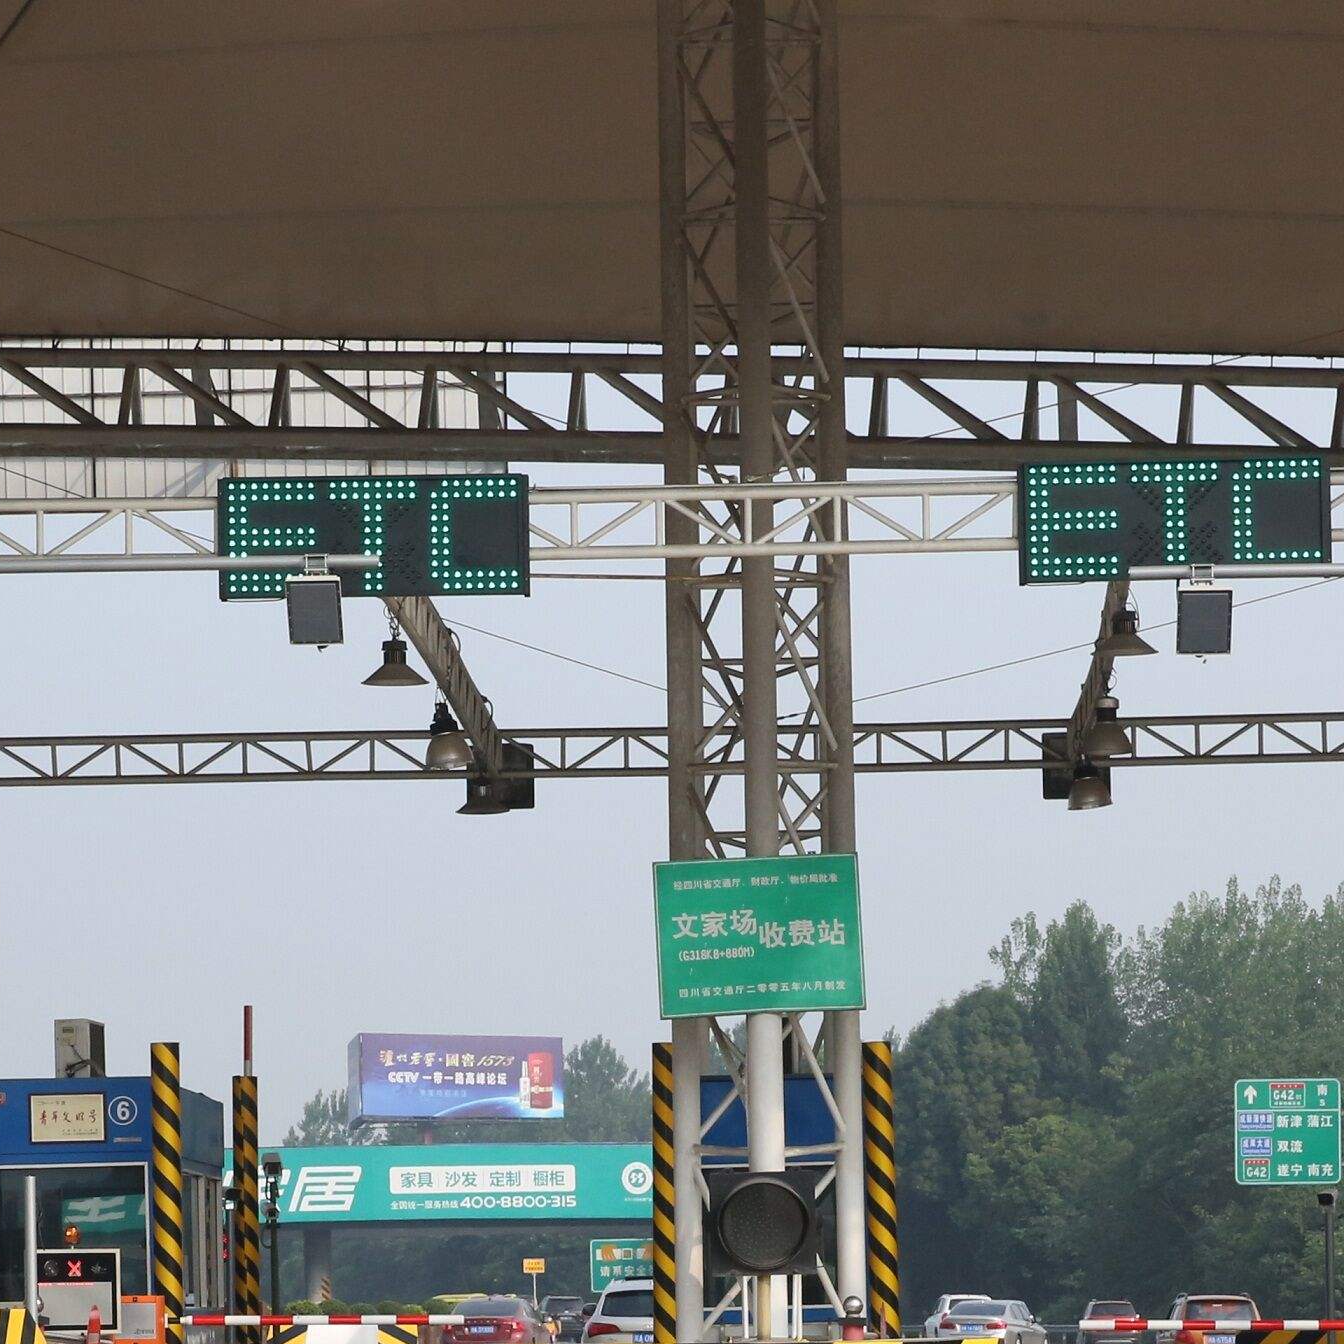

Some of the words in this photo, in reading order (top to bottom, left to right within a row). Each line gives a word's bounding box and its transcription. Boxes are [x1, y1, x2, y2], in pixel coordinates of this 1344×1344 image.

[1027, 460, 1323, 576] ETC
[228, 478, 520, 592] ETC
[672, 909, 757, 939] 文家场
[759, 918, 846, 948] 收费站
[388, 1071, 419, 1084] CCTV
[1276, 1115, 1302, 1128] 新津
[1277, 1140, 1303, 1153] 双流
[1246, 1167, 1267, 1177] G42
[1277, 1163, 1303, 1177] 遂宁
[1308, 1163, 1334, 1177] 南充
[400, 1172, 433, 1188] 家具
[445, 1171, 478, 1188] 沙发
[489, 1171, 522, 1187] 定制
[533, 1170, 565, 1187] 橱柜
[460, 1195, 577, 1208] 400-8800-315
